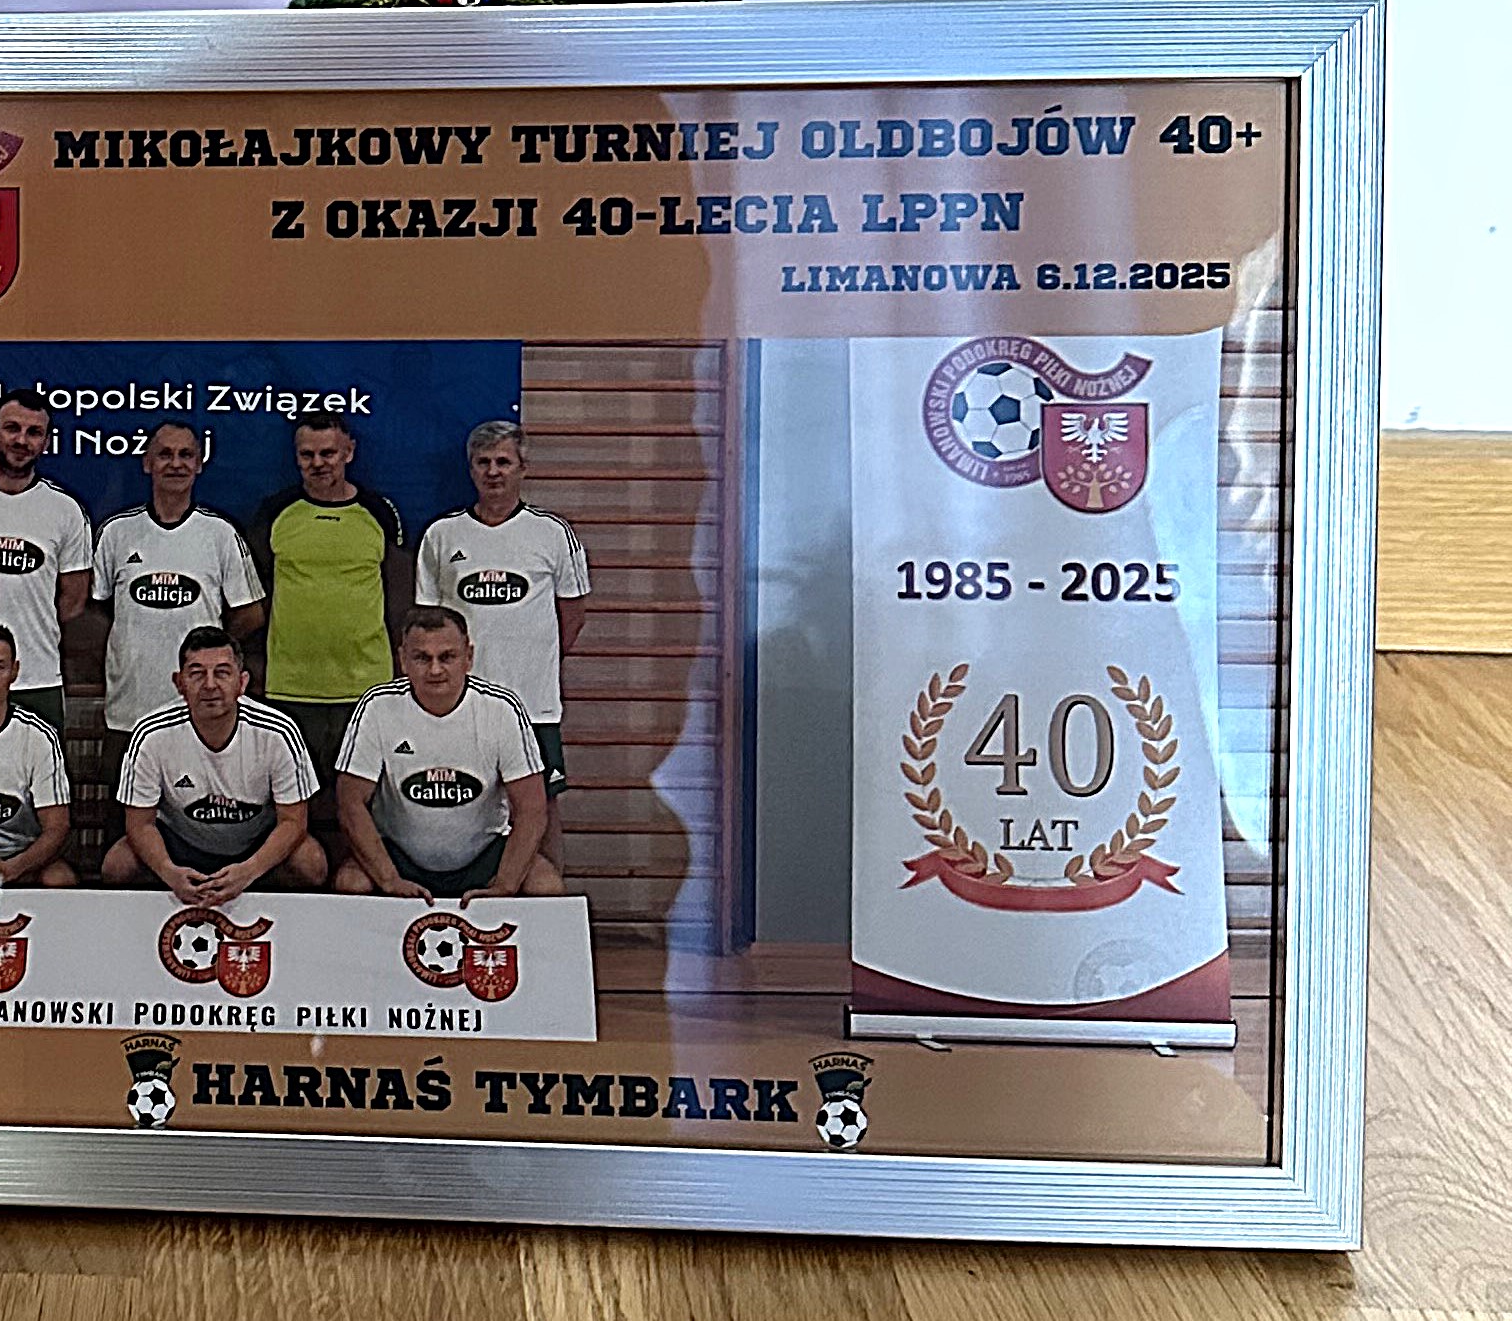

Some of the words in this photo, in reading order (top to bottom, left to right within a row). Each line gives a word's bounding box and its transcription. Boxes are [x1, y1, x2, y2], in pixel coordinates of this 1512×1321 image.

[53, 126, 492, 168] MIKOŁAJKOWY
[511, 120, 780, 164] TURNIEJ
[800, 105, 1136, 160] OLDBOJÓW
[1159, 116, 1263, 155] 40+
[271, 200, 307, 240] Z
[326, 196, 539, 238] OKAZJI
[561, 194, 839, 237] 40-LECIA
[862, 191, 1024, 233] LPPN
[781, 264, 1021, 293] LIMANOWA
[1036, 262, 1231, 292] 6.12.2025
[206, 384, 372, 420] Związek
[75, 428, 212, 464] Nożj
[136, 585, 193, 606] Galicja
[151, 573, 180, 586] MTM
[463, 582, 522, 601] Galicja
[896, 561, 1013, 603] 1985
[1061, 563, 1182, 603] 2025
[963, 693, 1115, 797] 40
[409, 782, 474, 804] Galicja
[999, 818, 1079, 852] LAT
[133, 1001, 277, 1032] PODOKRĘG
[296, 1004, 369, 1029] PIŁKI
[387, 1002, 484, 1033] NOŻNEJ
[191, 1057, 453, 1112] HARNAŚ
[475, 1070, 800, 1123] TYMBARK
